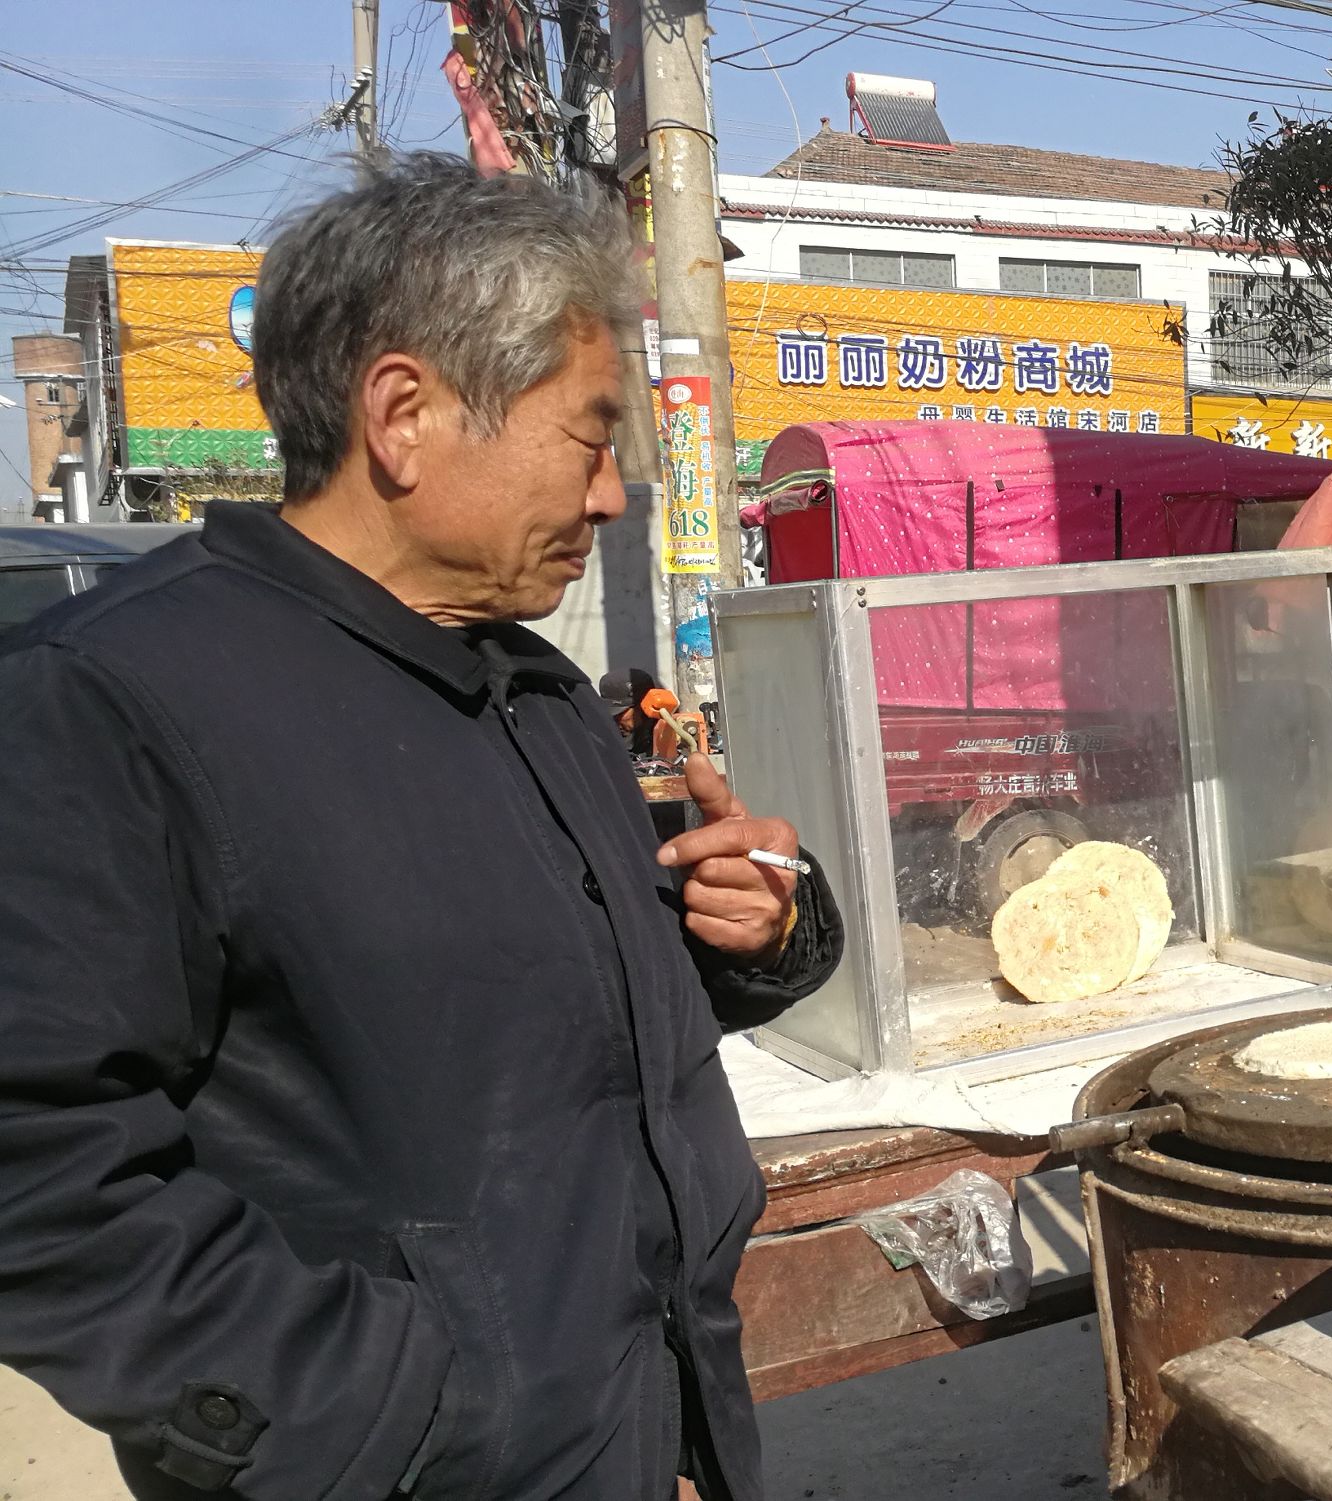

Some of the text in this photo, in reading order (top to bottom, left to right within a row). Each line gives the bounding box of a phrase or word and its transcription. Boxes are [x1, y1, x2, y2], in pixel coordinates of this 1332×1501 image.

[778, 334, 1113, 392] 丽丽奶粉商城
[920, 405, 1159, 433] 母婴生活馆宋河店
[669, 509, 710, 537] 618
[1015, 735, 1104, 755] 中国淮海
